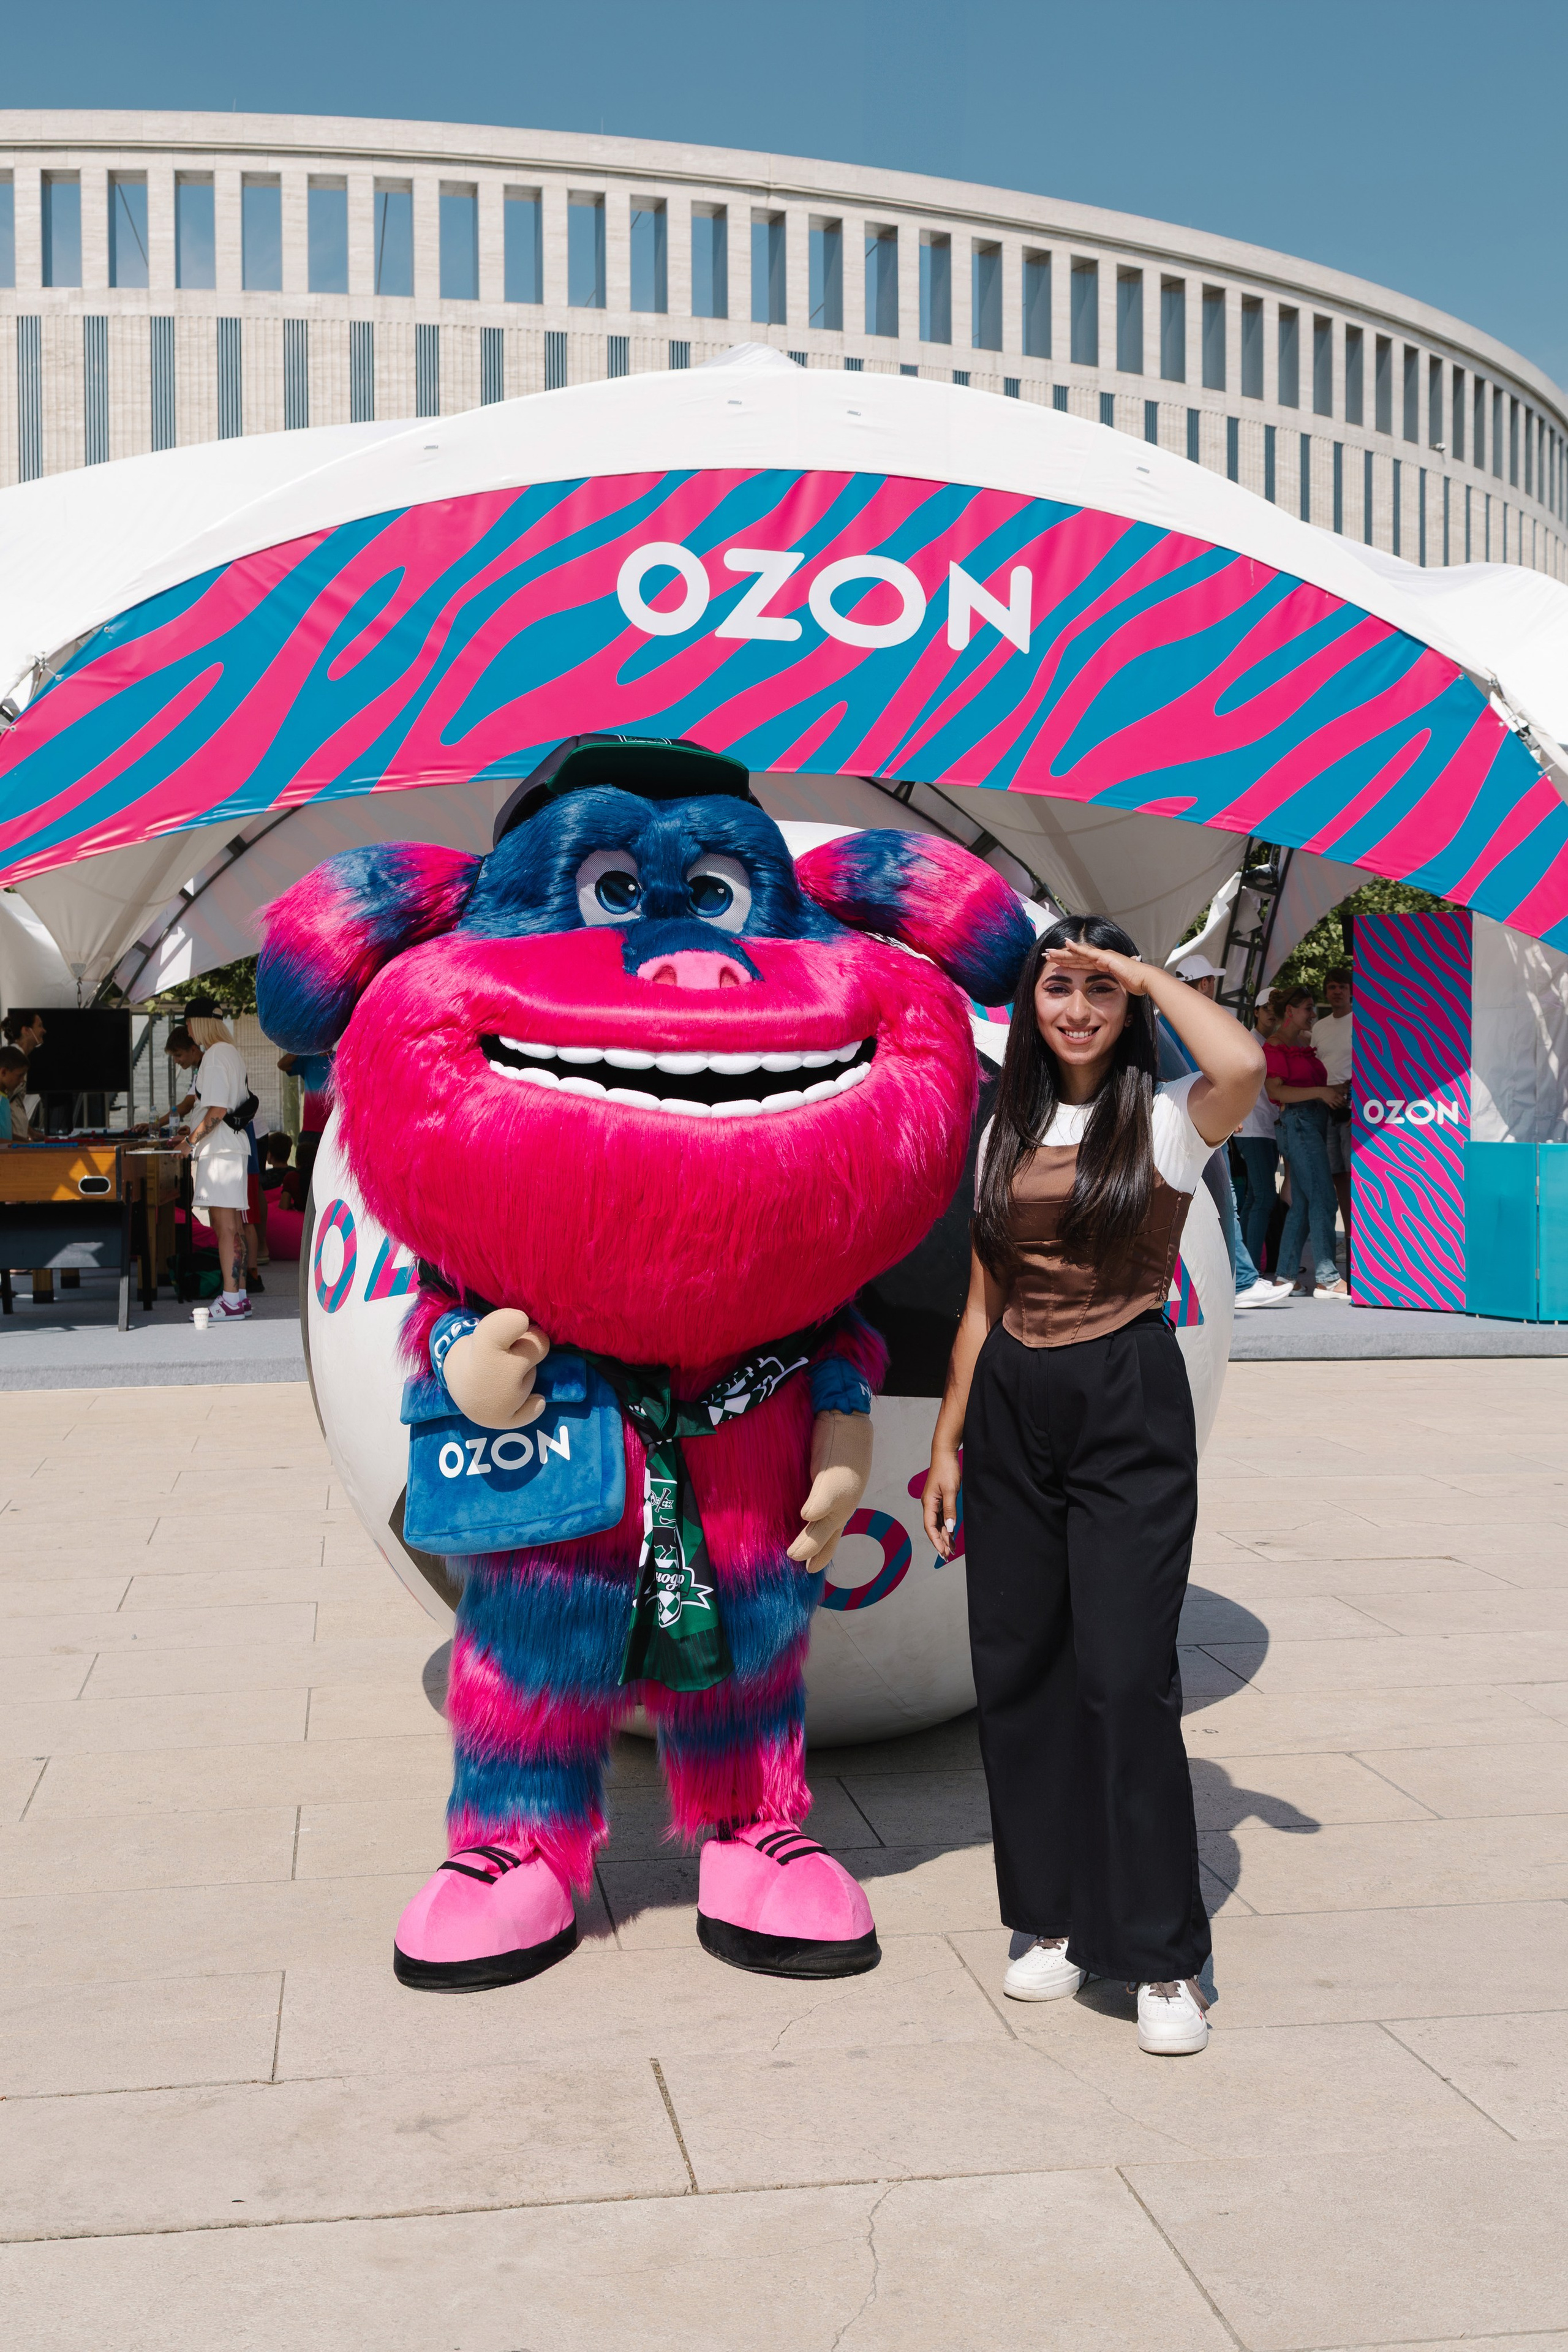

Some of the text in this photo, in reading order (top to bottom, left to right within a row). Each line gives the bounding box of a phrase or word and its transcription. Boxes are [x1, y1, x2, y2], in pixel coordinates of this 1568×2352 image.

[616, 541, 1033, 655] OZON
[1363, 1099, 1459, 1125] OZON
[439, 1425, 570, 1479] OZON
